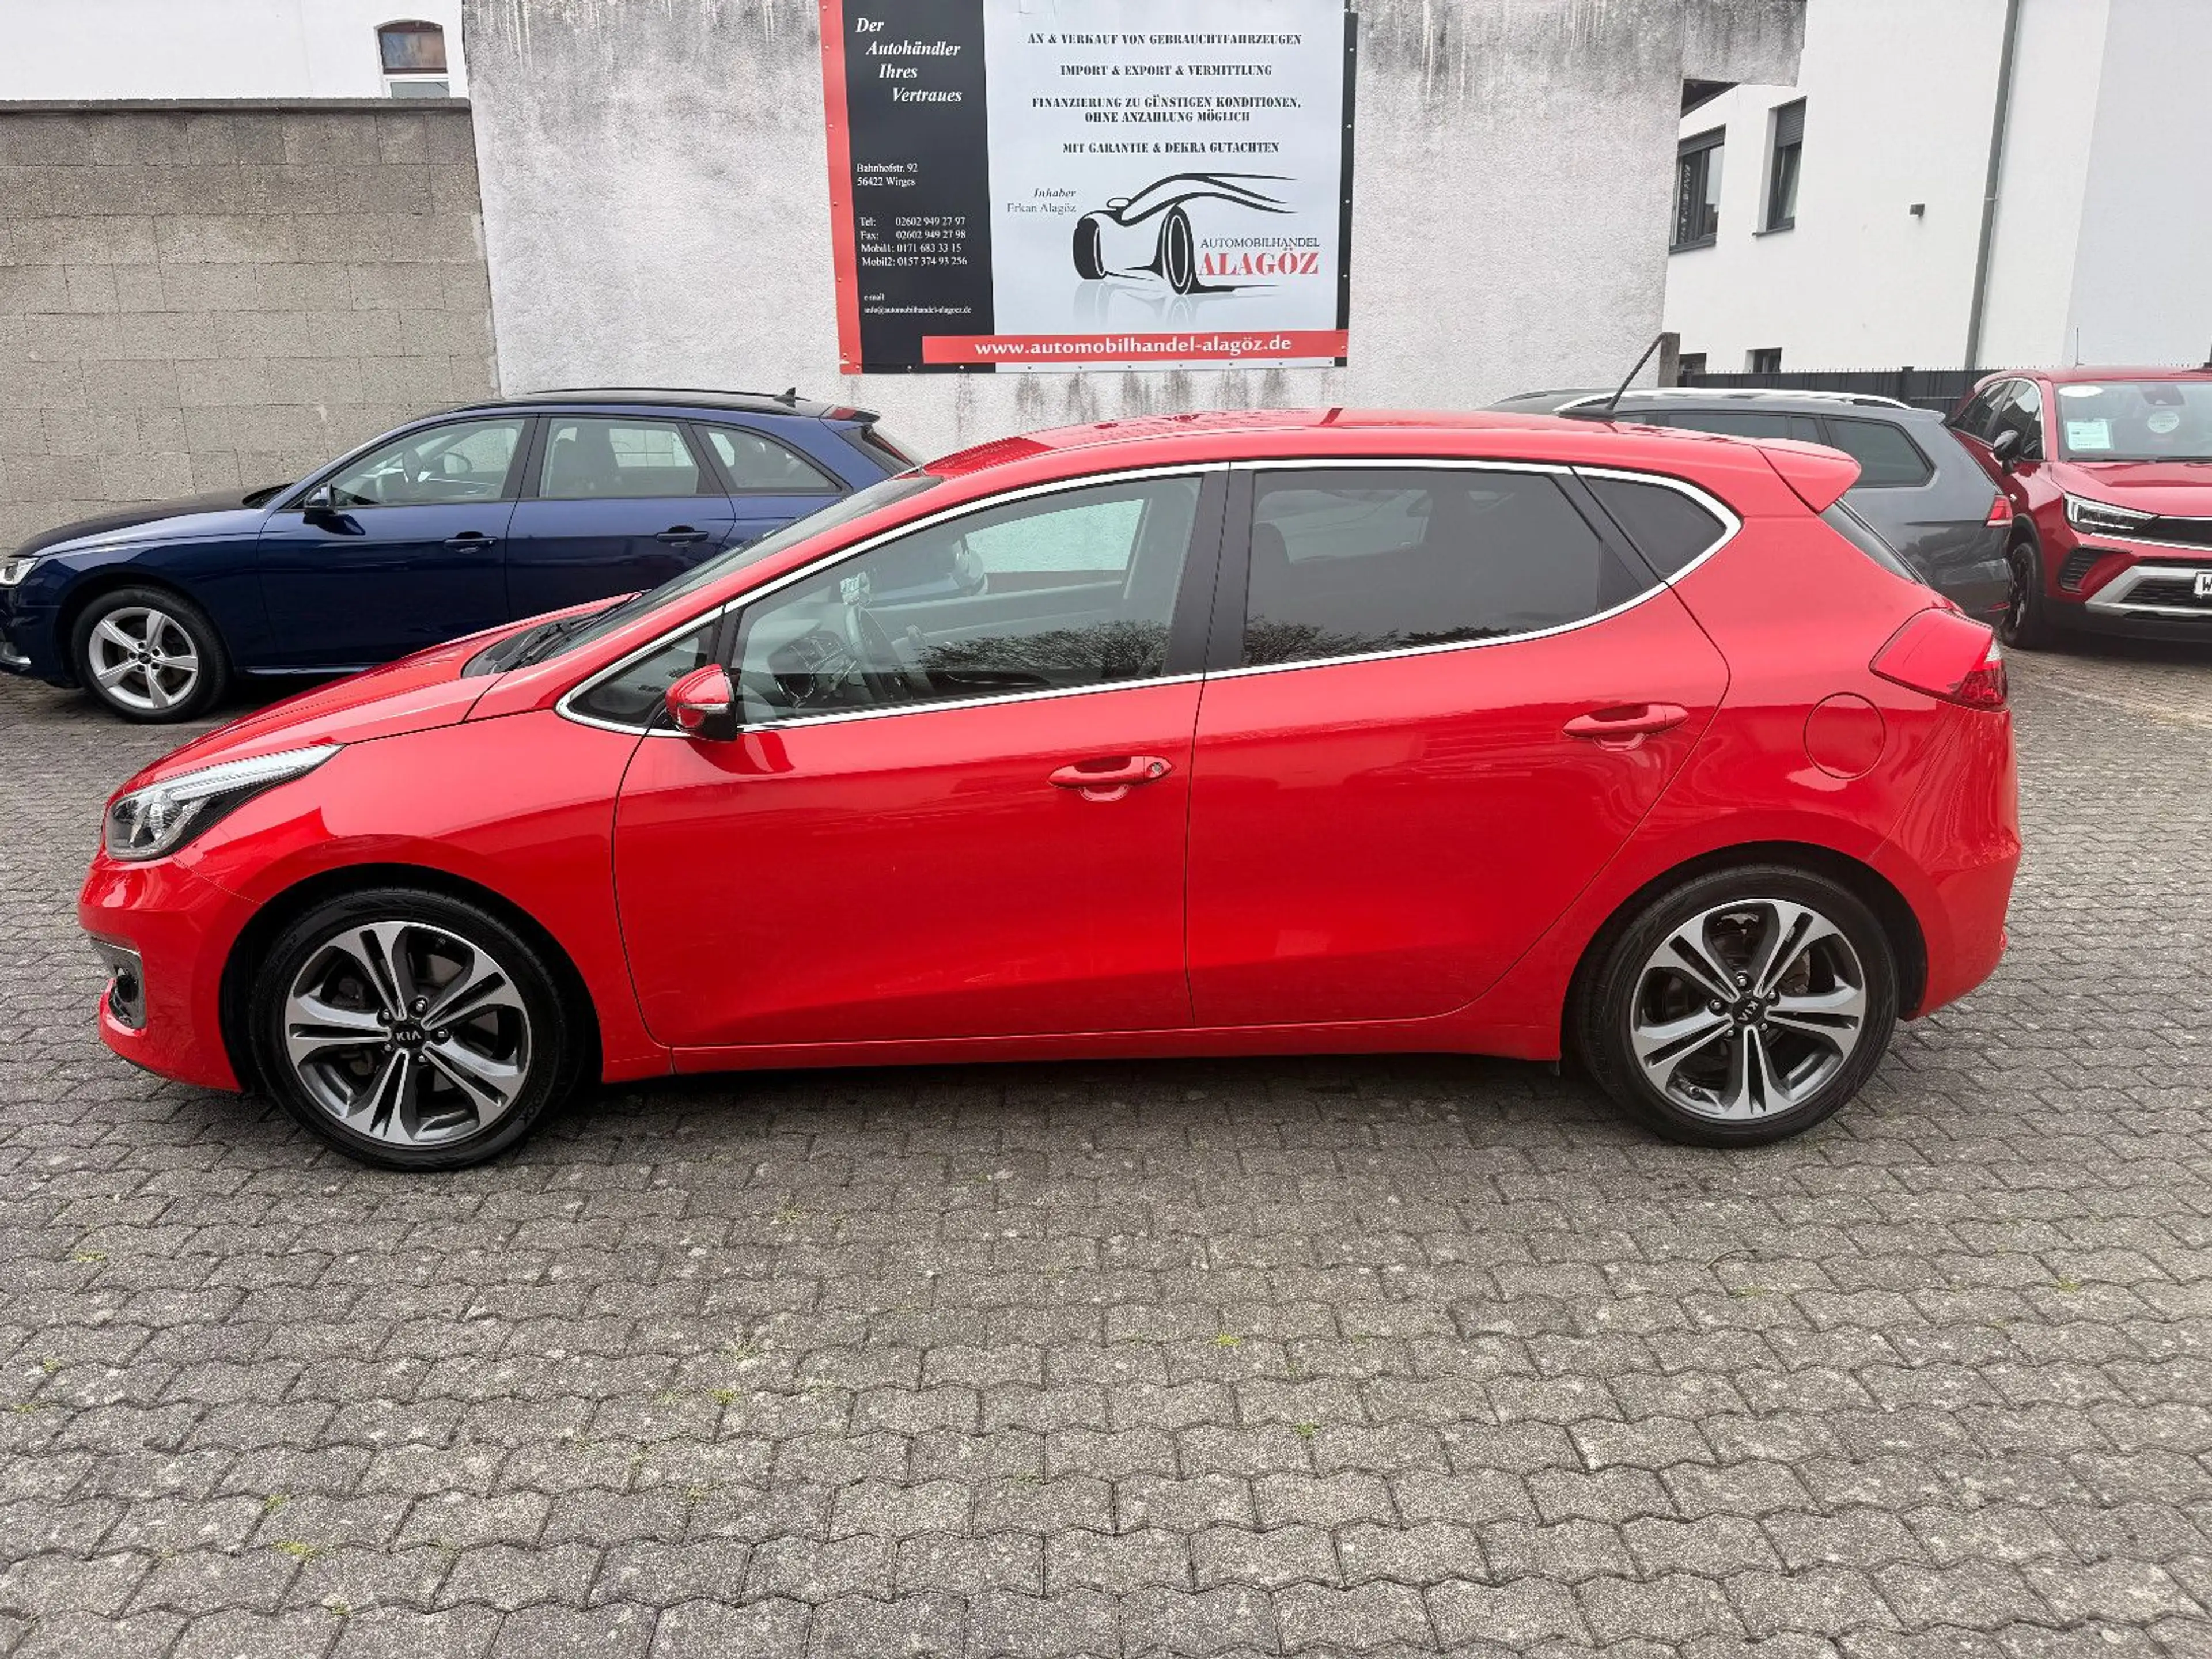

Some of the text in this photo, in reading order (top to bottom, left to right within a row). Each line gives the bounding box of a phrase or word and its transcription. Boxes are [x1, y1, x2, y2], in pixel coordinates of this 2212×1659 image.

[855, 17, 885, 33] Der
[1027, 33, 1302, 44] AN & VERKAUF VON GEBRAUCHTFAHRZEUGEN
[865, 40, 961, 56] Autohändler
[878, 63, 918, 78] Ihres
[1060, 65, 1272, 75] IMPORT & EXPORT & VERMITTLUNG
[893, 87, 963, 102] Vertraues
[1032, 94, 1301, 108] FINANZIERUNG ZU GÜNSTIGEN KONDITIONEN,
[1085, 109, 1250, 122] OHNE ANZAHLUNG MÖGLICH
[1063, 142, 1279, 153] MIT GARANTIE & DEKRA GUTACHTEN
[857, 163, 918, 172] Bahnhofstr. 92
[857, 177, 916, 187] 56422 Wirges
[1033, 187, 1077, 198] Inhaber
[1040, 203, 1077, 215] Alagöz
[859, 217, 965, 226] Tel: 02602 949 27 97
[860, 231, 879, 240] Fax:
[895, 230, 922, 240] 02602
[925, 230, 941, 240] 949
[955, 230, 966, 239] 98
[896, 243, 917, 252] 0171
[920, 243, 936, 252] 683
[938, 243, 949, 252] 33
[951, 243, 962, 252] 15
[1200, 237, 1320, 248] AUTOMOBILHANDEL
[862, 257, 895, 266] Mobil2:
[897, 257, 919, 266] 0157
[921, 257, 937, 266] 374
[951, 257, 968, 266] 256
[1198, 247, 1319, 275] ALAGÖZ
[974, 335, 1291, 356] www.automobilhandel-alagöz.de
[396, 1030, 422, 1041] KIA
